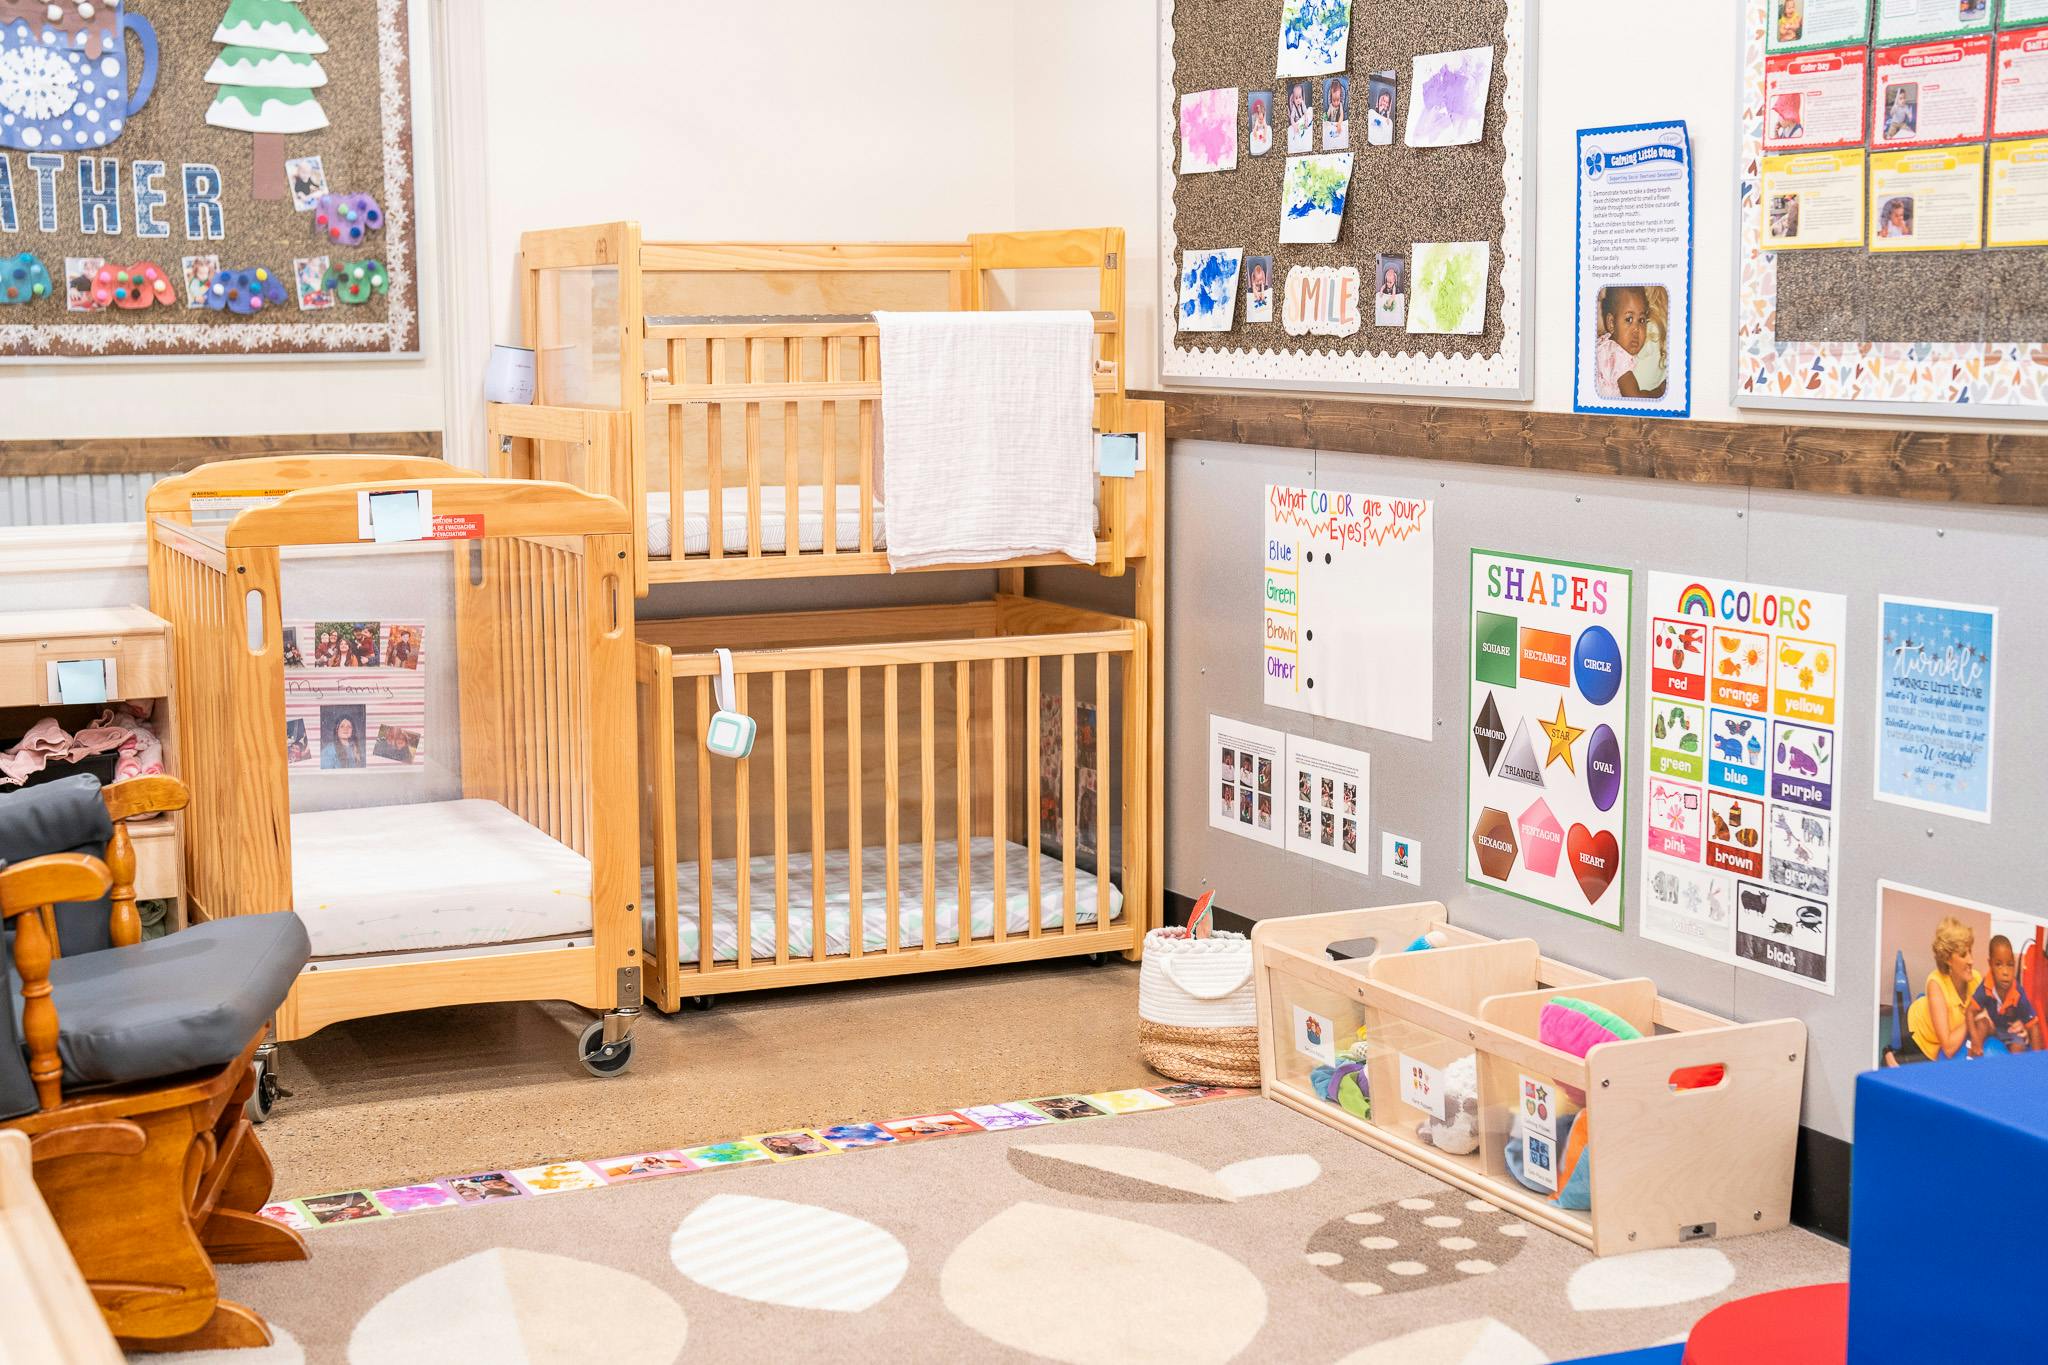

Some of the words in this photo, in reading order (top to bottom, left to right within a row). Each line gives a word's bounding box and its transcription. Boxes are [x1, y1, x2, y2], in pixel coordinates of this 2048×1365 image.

[1638, 148, 1658, 161] Little
[1288, 276, 1354, 325] SMILE
[1277, 488, 1307, 511] What
[1310, 490, 1354, 517] COLOR
[1363, 499, 1382, 517] are
[1389, 500, 1420, 526] your
[1330, 516, 1372, 550] Eyes?
[1270, 540, 1292, 561] Blue
[1266, 578, 1296, 606] Green
[1488, 564, 1608, 615] SHAPES
[1720, 589, 1812, 631] COLORS
[1267, 617, 1296, 645] Brown
[1268, 656, 1296, 679] Other
[1482, 642, 1510, 656] SQUARE
[1523, 648, 1567, 666] RECTANGLE
[1584, 658, 1612, 673] CIRCLE
[288, 680, 324, 700] My
[336, 679, 395, 699] Family
[1668, 676, 1688, 691] red
[1718, 685, 1760, 707] orange
[1784, 696, 1824, 716] yellow
[1474, 726, 1506, 741] DIAMOND
[1551, 728, 1570, 742] STAR
[1505, 764, 1540, 782] TRIANGLE
[1593, 760, 1615, 775] OVAL
[1660, 756, 1692, 773] green
[1723, 767, 1748, 786] blue
[1781, 782, 1823, 802] purple
[1478, 834, 1513, 854] HEXAGON
[1522, 823, 1561, 844] PENTAGON
[1579, 852, 1606, 869] HEART
[1664, 838, 1686, 854] pink
[1714, 848, 1754, 871] brown
[1784, 869, 1812, 889] gray
[1672, 918, 1704, 936] white
[1766, 944, 1796, 967] black
